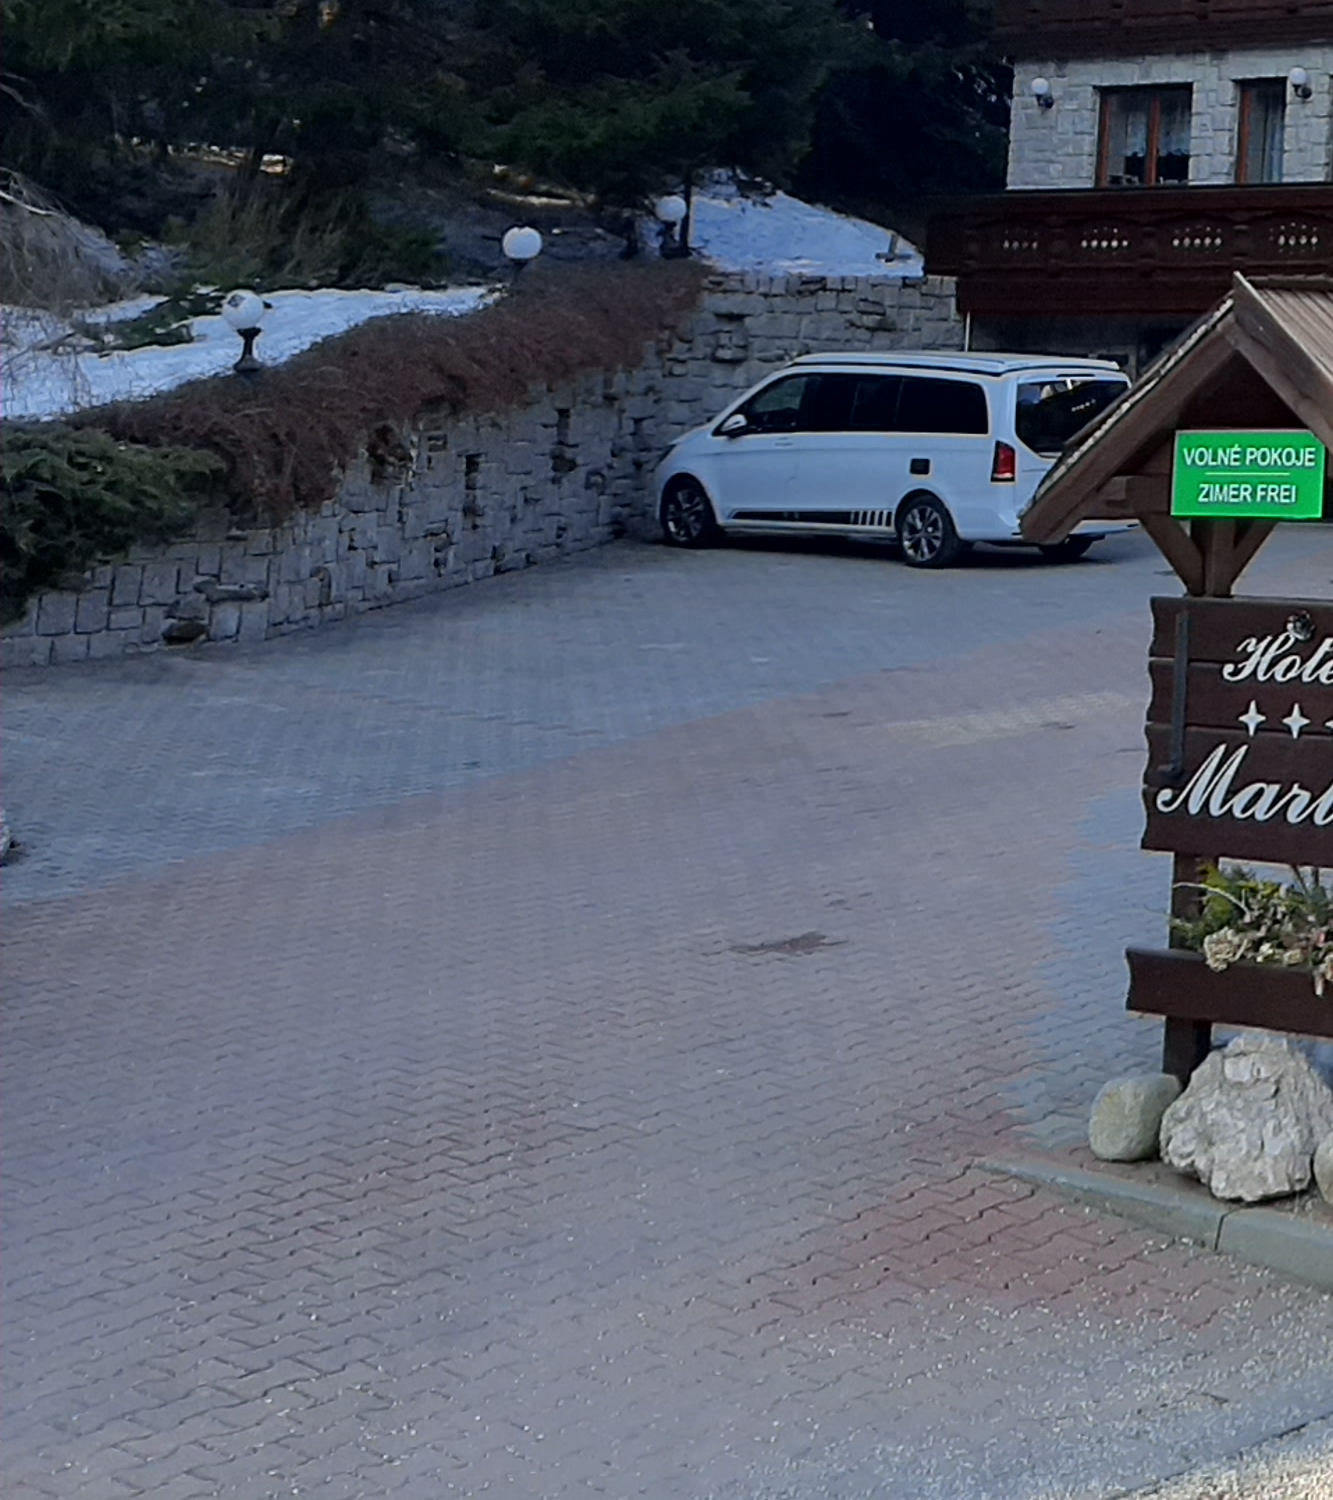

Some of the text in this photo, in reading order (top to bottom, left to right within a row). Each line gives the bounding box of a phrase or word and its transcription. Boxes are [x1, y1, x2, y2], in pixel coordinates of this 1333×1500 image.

[1183, 443, 1316, 467] VOLNÉ POKOJE
[1198, 483, 1297, 503] ZIMER FREI
